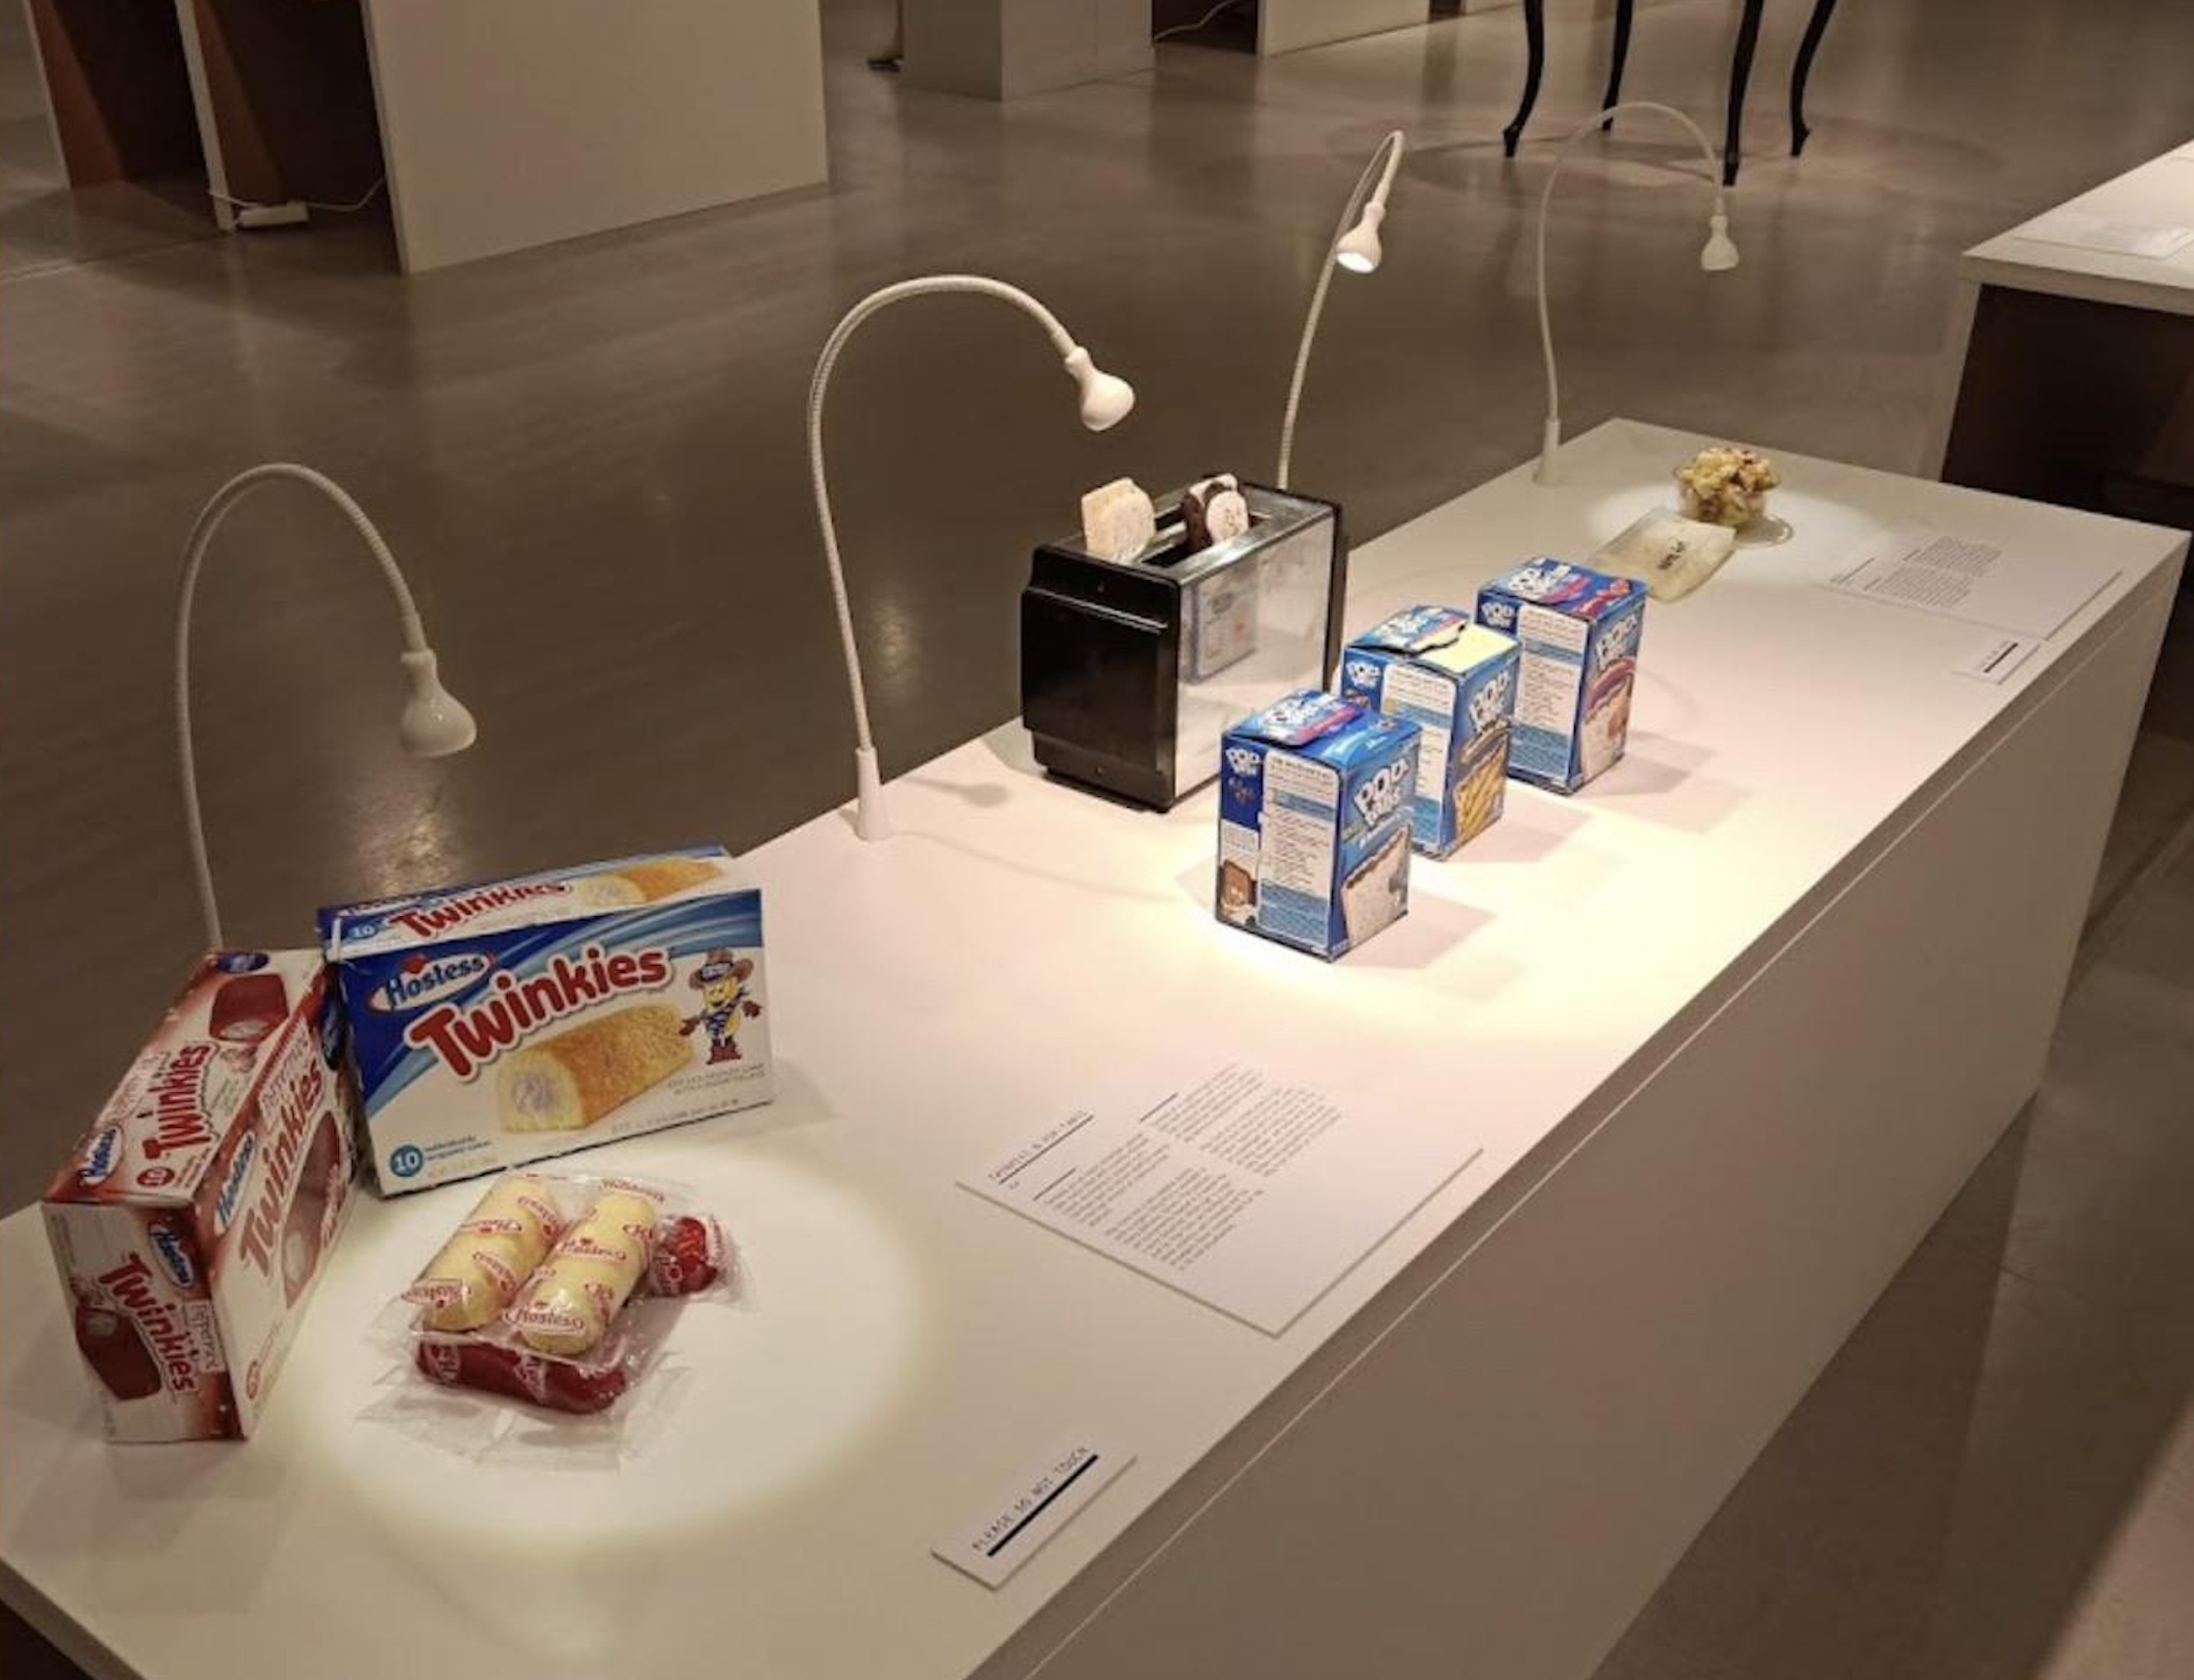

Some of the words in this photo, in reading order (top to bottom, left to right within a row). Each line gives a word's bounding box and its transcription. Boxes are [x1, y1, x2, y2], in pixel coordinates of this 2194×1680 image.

[384, 960, 485, 1009] Hostess
[408, 945, 669, 1077] Twinkies
[137, 1044, 213, 1159] Twinkies
[238, 1054, 322, 1278] Twinkies
[393, 1151, 420, 1172] 10
[99, 1252, 199, 1391] Twinkies
[505, 1309, 584, 1331] Hostess
